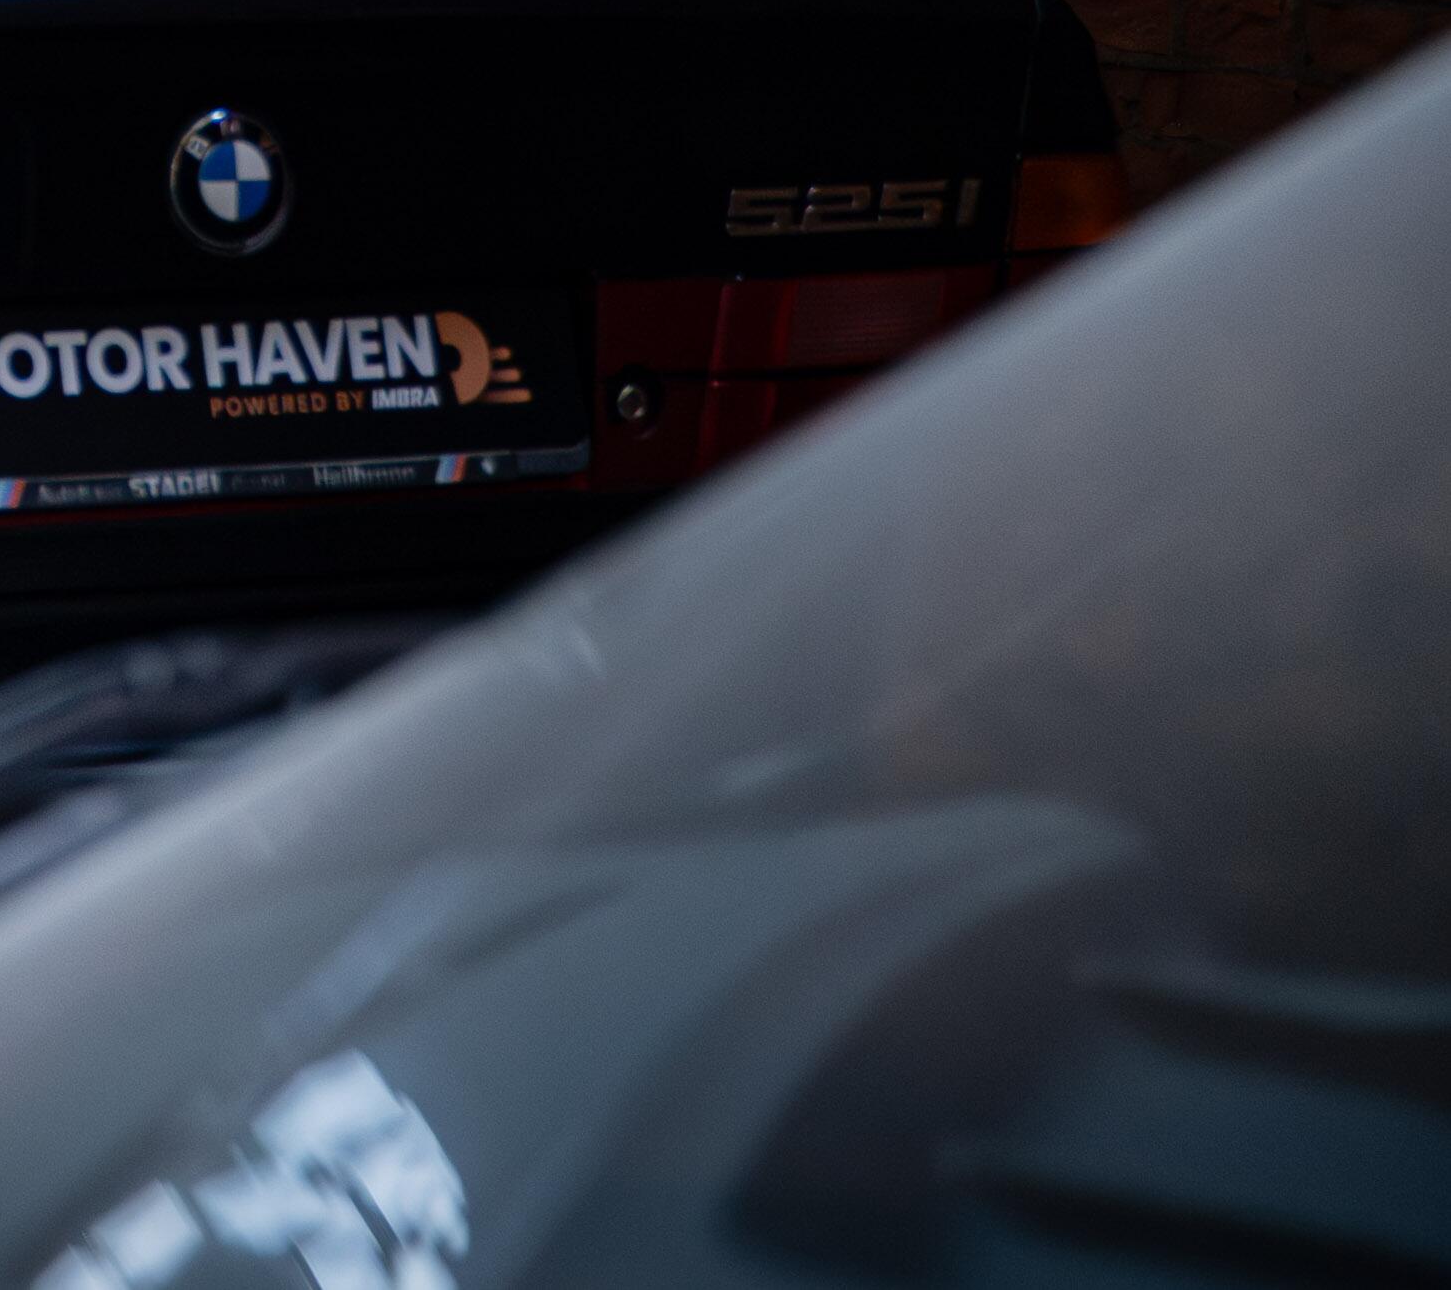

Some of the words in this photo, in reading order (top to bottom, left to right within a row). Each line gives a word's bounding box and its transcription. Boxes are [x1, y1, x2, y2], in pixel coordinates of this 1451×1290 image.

[200, 314, 436, 389] HAVEN
[209, 390, 328, 421] POWERED
[336, 389, 365, 413] BY
[371, 385, 440, 411] IMBRA
